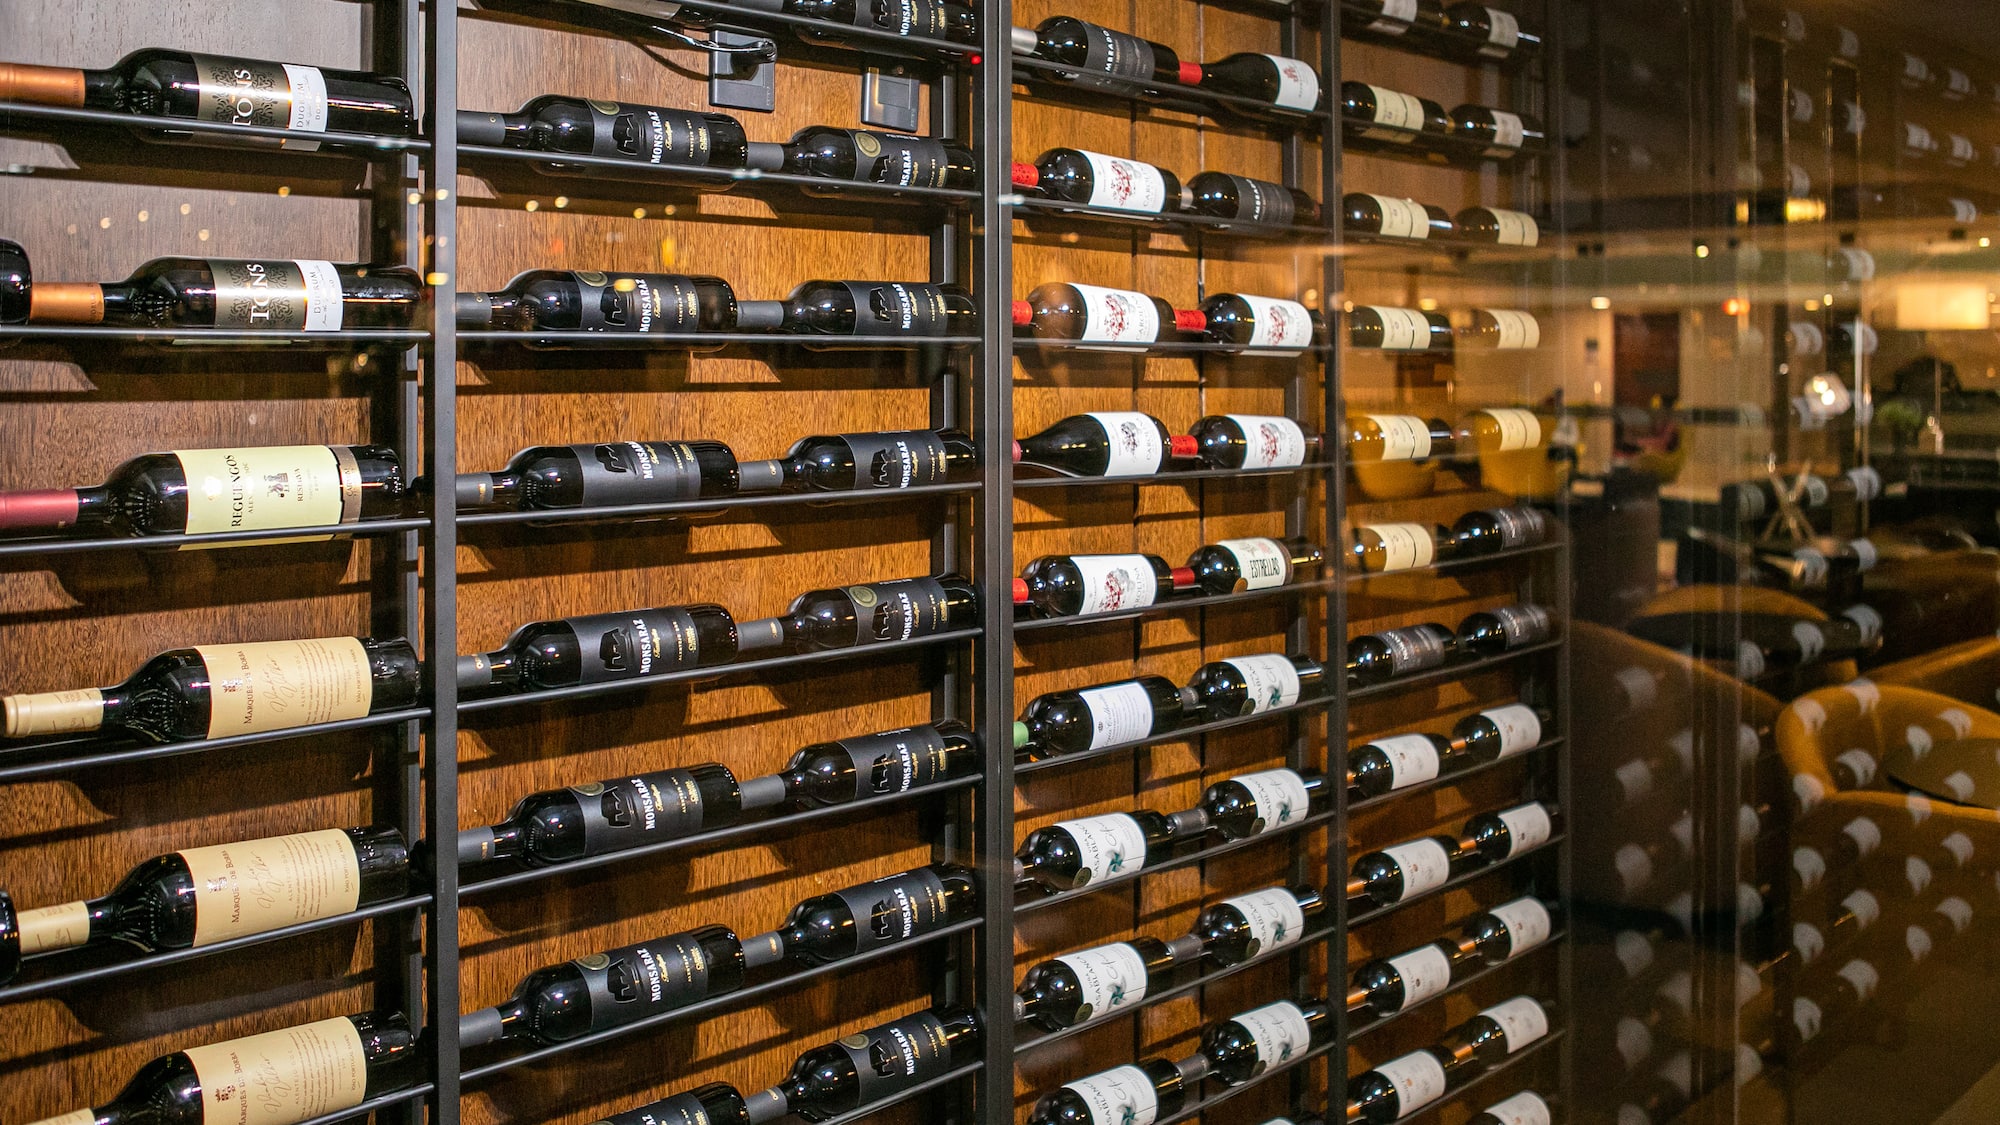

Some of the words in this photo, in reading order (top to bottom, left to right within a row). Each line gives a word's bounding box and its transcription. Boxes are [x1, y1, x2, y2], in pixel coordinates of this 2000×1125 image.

[647, 110, 664, 164] MONSARAZ
[246, 263, 270, 324] TONS
[635, 278, 652, 332] MONSARAZ
[892, 283, 912, 330] MONSARAZ
[896, 440, 911, 489] MONSARAZ
[1249, 557, 1280, 579] ESTRELLAS
[898, 592, 913, 641] MONSARAZ
[633, 618, 652, 674] MONSARAZ
[896, 742, 912, 793] MONSARAZ
[631, 778, 656, 831] MONSARAZ
[221, 850, 234, 870] BORBA
[1074, 822, 1100, 879] CASABLANCA
[893, 887, 912, 939] MONSARAZ
[637, 947, 662, 1003] MONSARAZ
[230, 1051, 242, 1075] BORBA
[890, 1027, 915, 1076] MONSARAZ
